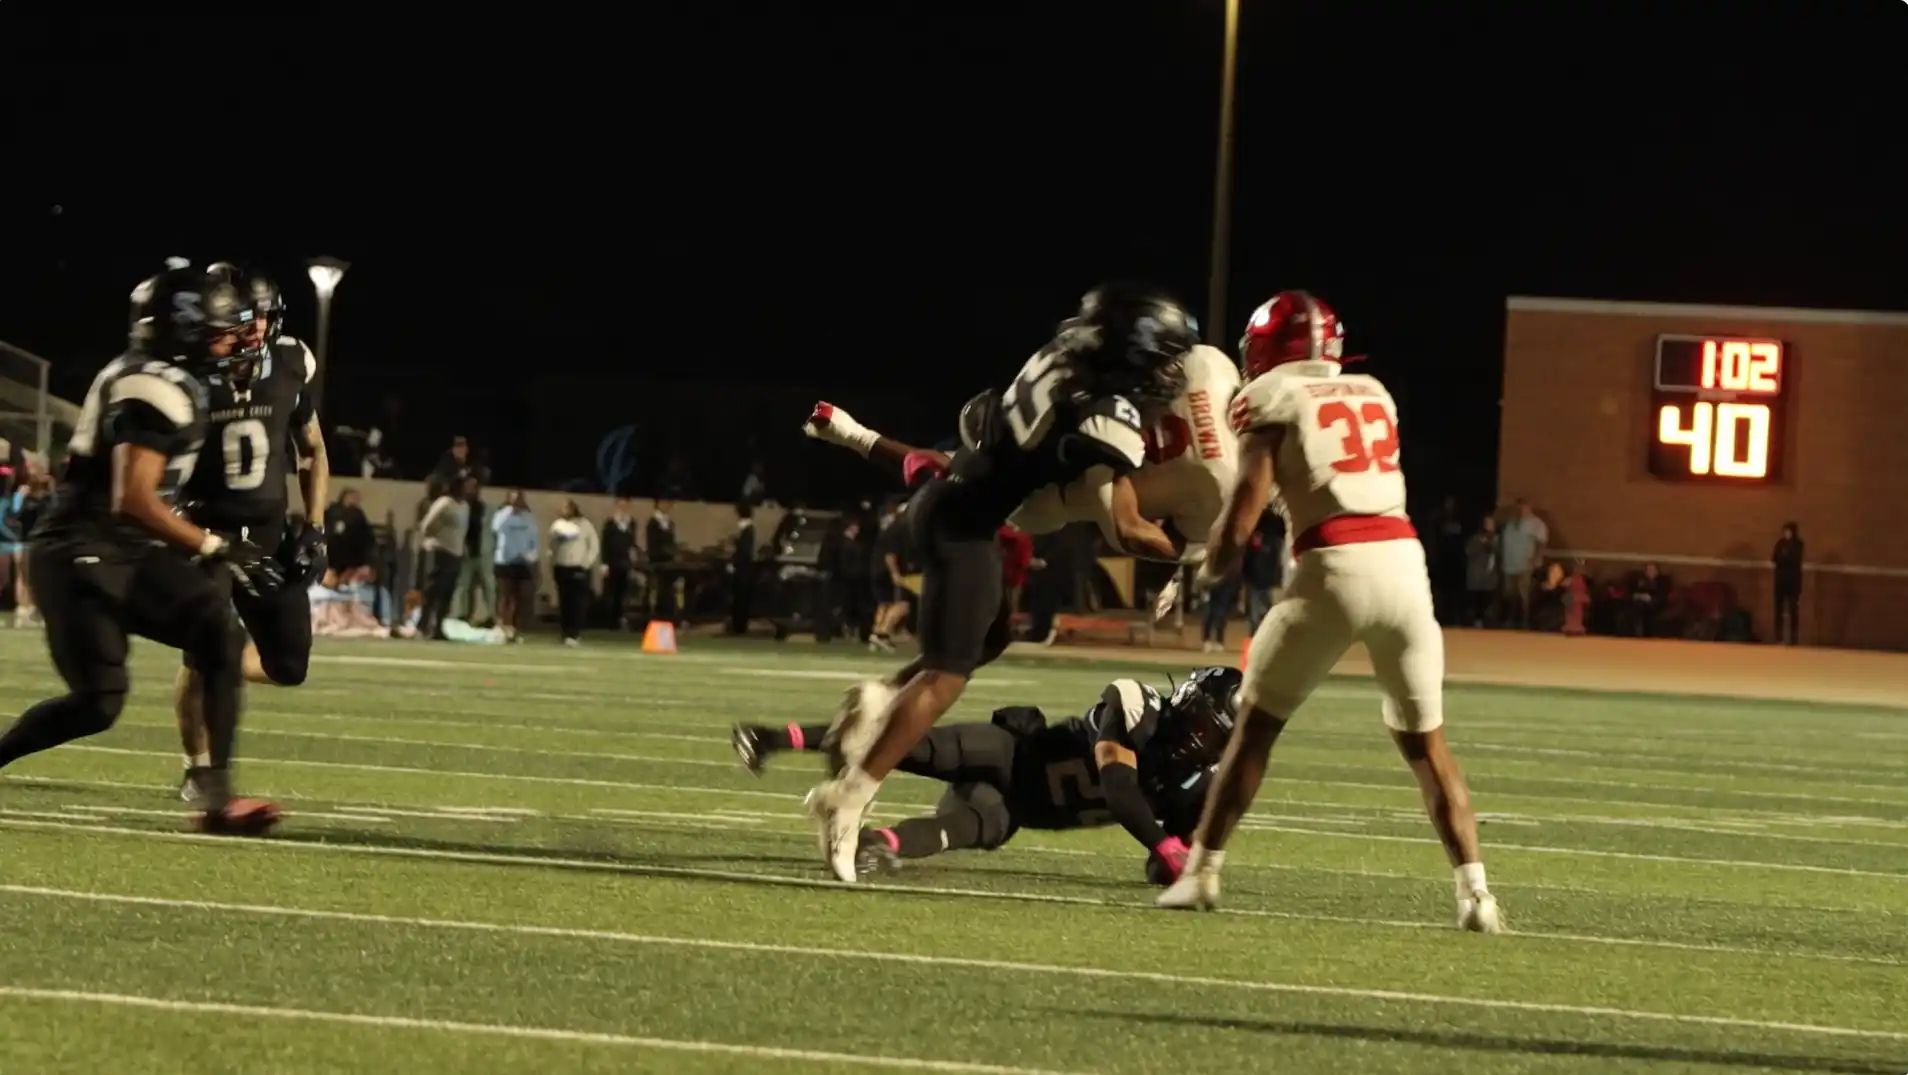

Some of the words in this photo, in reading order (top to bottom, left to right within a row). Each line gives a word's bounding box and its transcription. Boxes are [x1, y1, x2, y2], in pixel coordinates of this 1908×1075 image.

[222, 419, 270, 490] 0
[1189, 390, 1222, 460] BROWN
[1318, 401, 1399, 473] 32
[1659, 402, 1770, 478] 40
